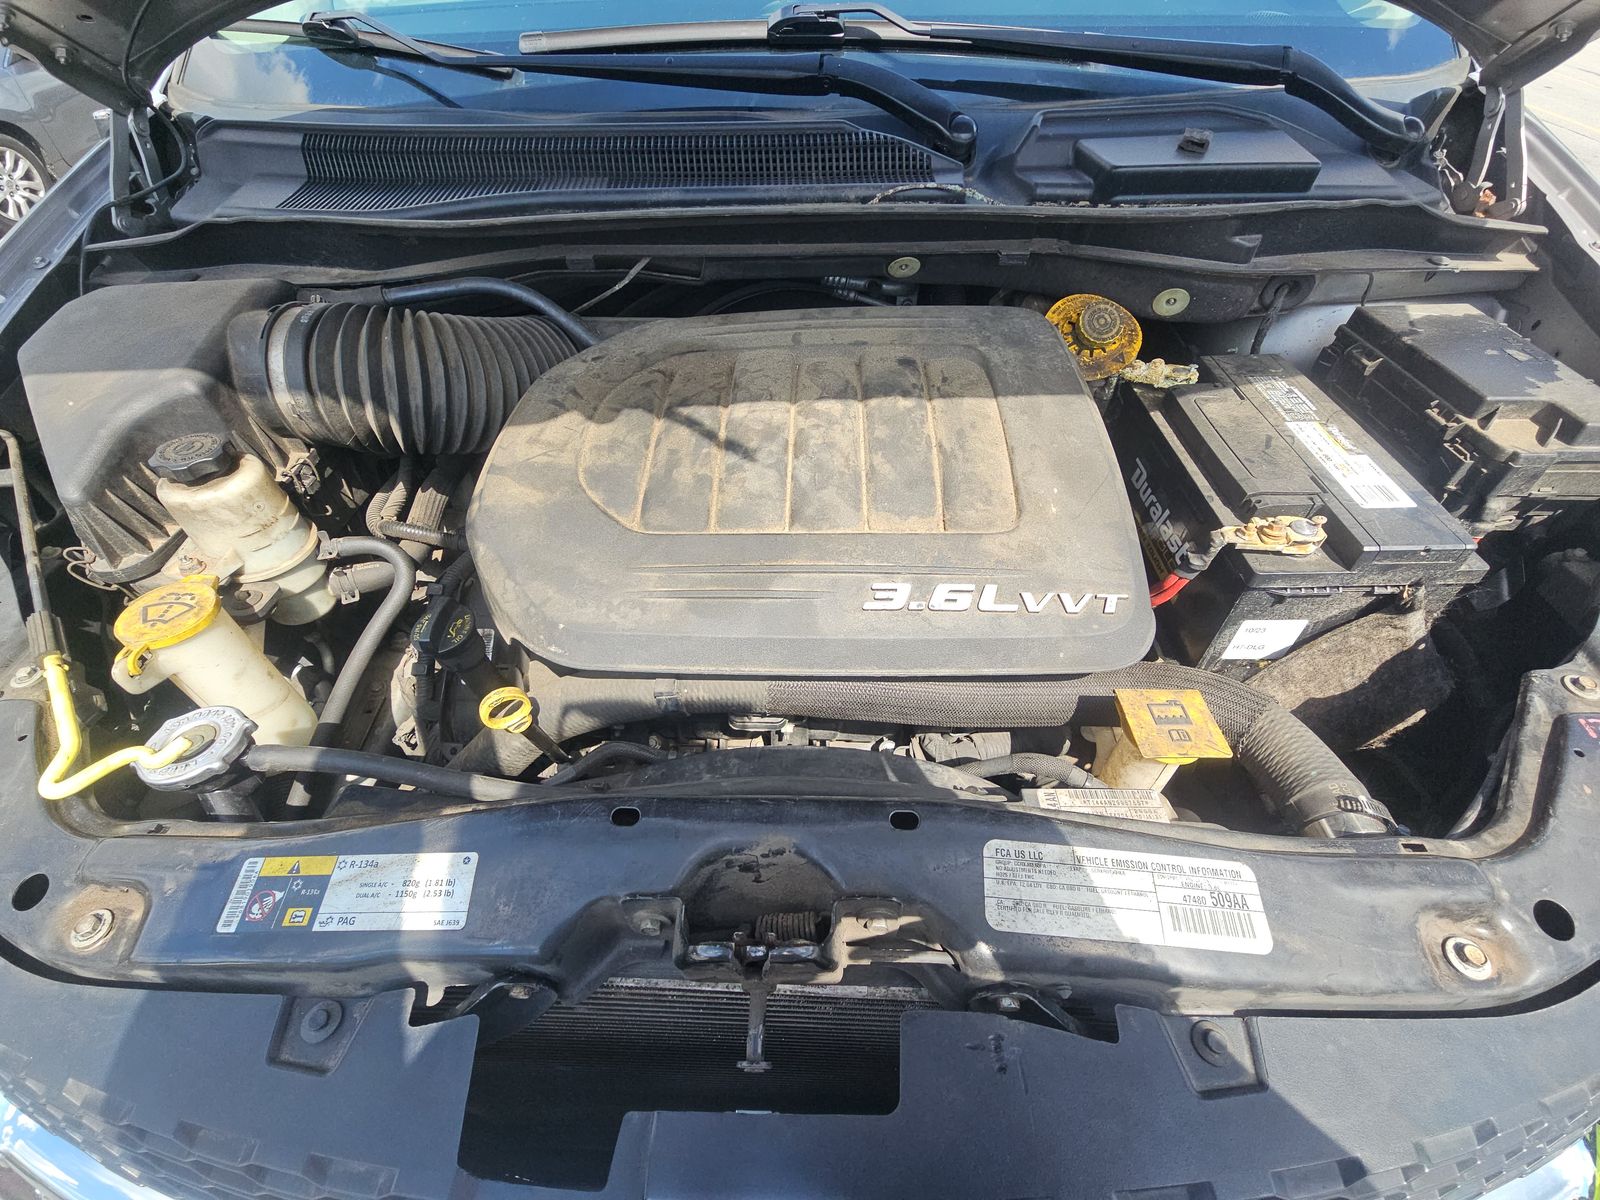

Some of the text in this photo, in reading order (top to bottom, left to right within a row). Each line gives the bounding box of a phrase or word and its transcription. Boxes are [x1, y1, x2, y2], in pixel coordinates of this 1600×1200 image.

[1131, 457, 1189, 566] Duralast
[862, 582, 1129, 615] 3.6L VVT
[995, 848, 1044, 860] FCA US LLC
[349, 859, 379, 869] R-134a
[1076, 855, 1109, 867] VEHICLE
[1111, 858, 1149, 870] EMISSION
[1150, 862, 1187, 874] CONTROL
[1188, 866, 1242, 880] INFORMATION
[402, 879, 421, 888] 820g
[424, 879, 444, 887] (1.81
[445, 878, 456, 887] lb)
[395, 890, 417, 899] 1150g
[423, 889, 442, 898] (2.53
[443, 889, 455, 898] lb)
[1182, 891, 1250, 910] 47480 509AA
[336, 916, 356, 926] PAG
